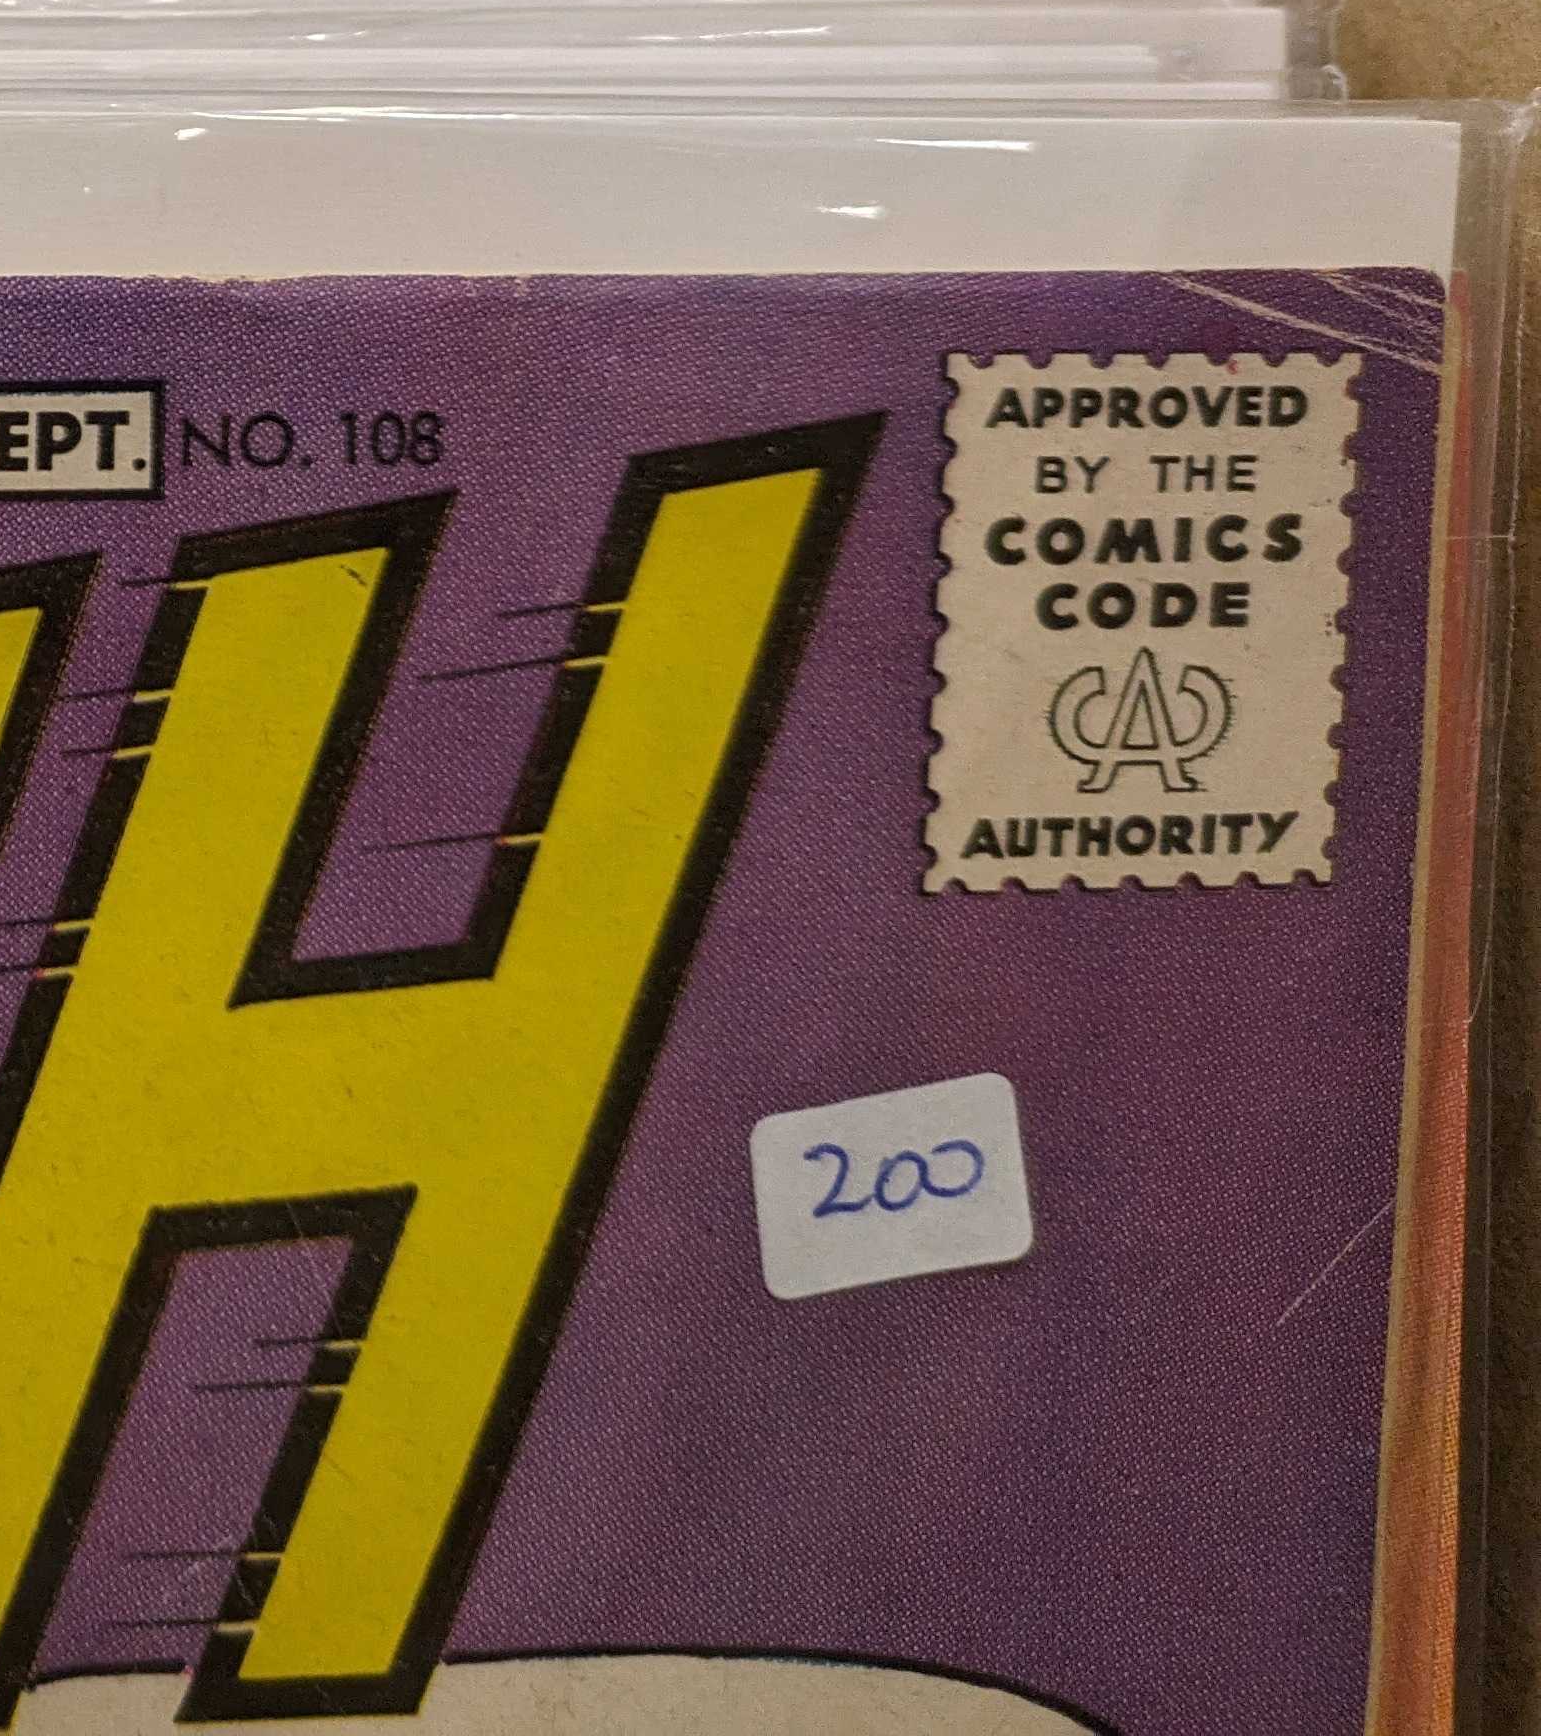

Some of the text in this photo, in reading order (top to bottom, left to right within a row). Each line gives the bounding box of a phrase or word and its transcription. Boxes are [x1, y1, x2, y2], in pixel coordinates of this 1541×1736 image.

[985, 385, 1309, 429] APPROVED
[182, 410, 311, 469] NO.
[341, 410, 444, 466] 108
[1034, 454, 1259, 494] BY THE
[984, 513, 1303, 565] COMICS
[1035, 582, 1251, 630] CODE
[960, 810, 1300, 860] AUTHORITY
[803, 1139, 985, 1218] 200
